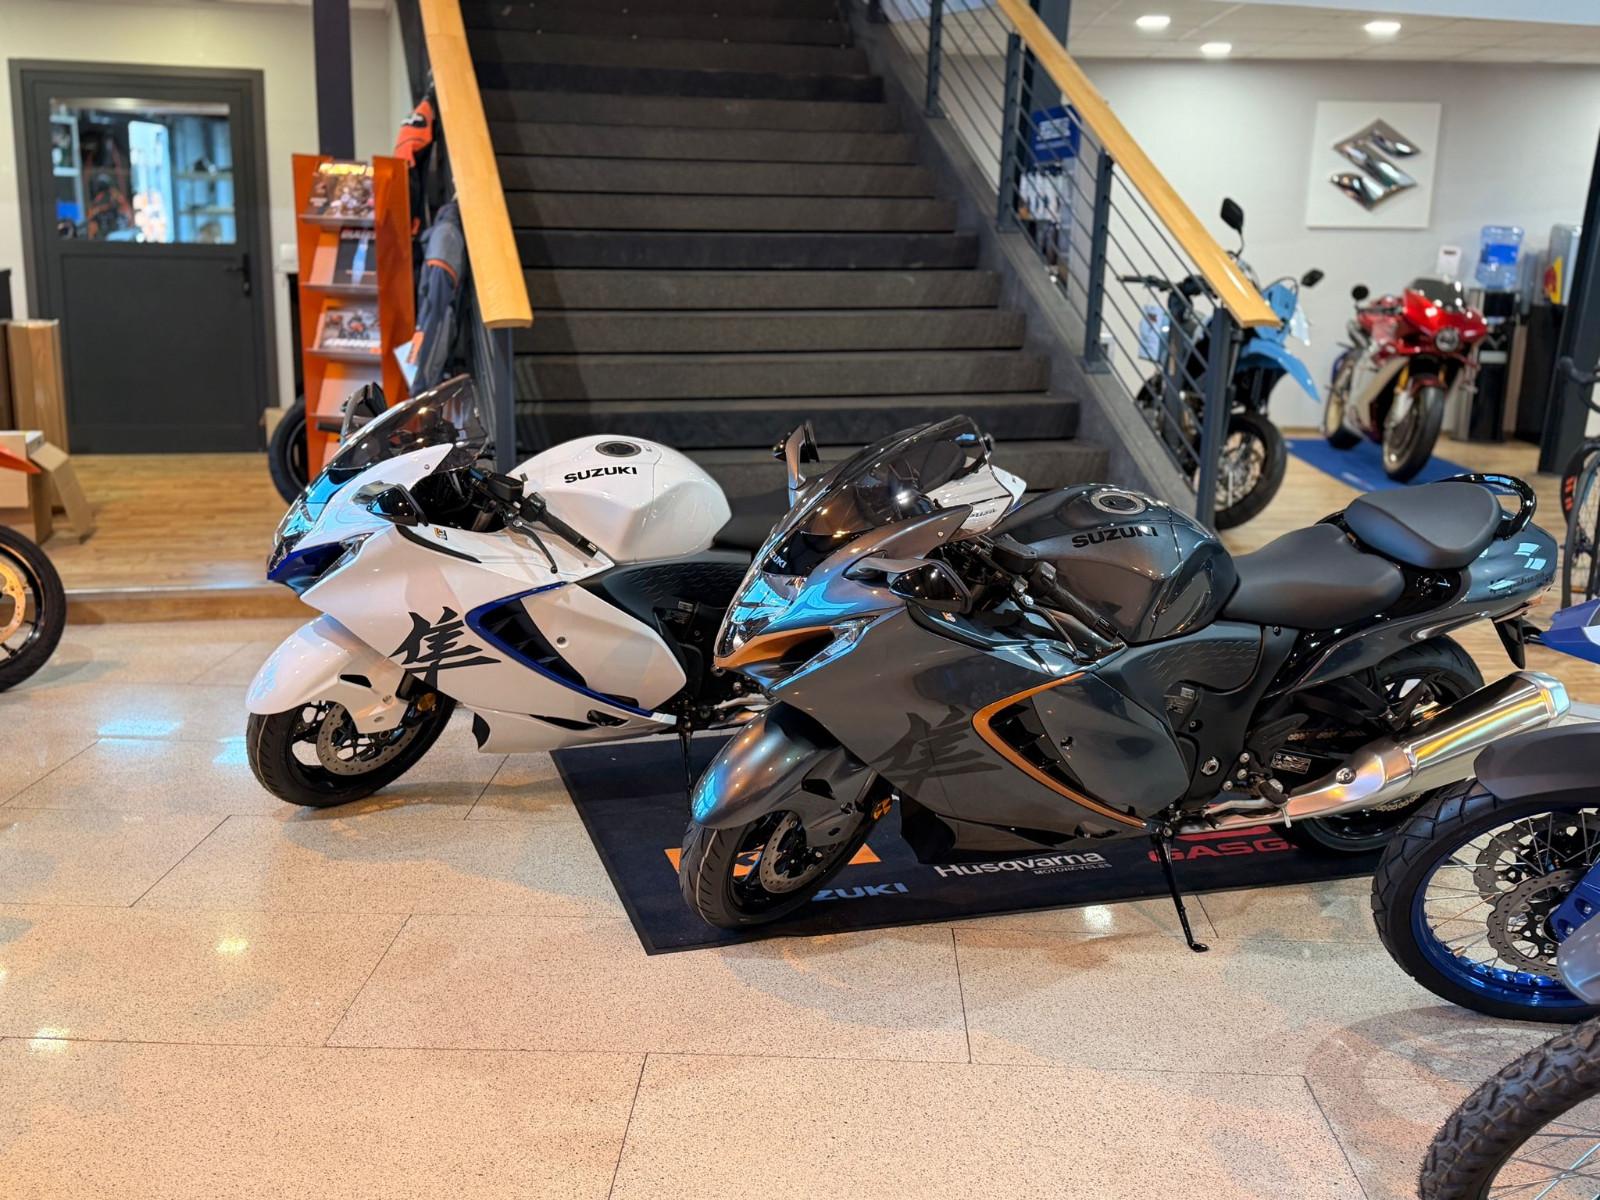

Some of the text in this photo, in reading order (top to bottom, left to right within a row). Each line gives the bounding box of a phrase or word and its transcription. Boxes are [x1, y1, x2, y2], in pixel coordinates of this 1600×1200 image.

[564, 466, 638, 484] SUZUKI
[1072, 526, 1159, 548] SUZUKI
[388, 606, 502, 690] 隼
[1147, 838, 1290, 862] GASG
[934, 852, 1106, 878] Husqvarna
[1032, 863, 1112, 875] MOTORCYCLES
[811, 882, 909, 902] ZUKI
